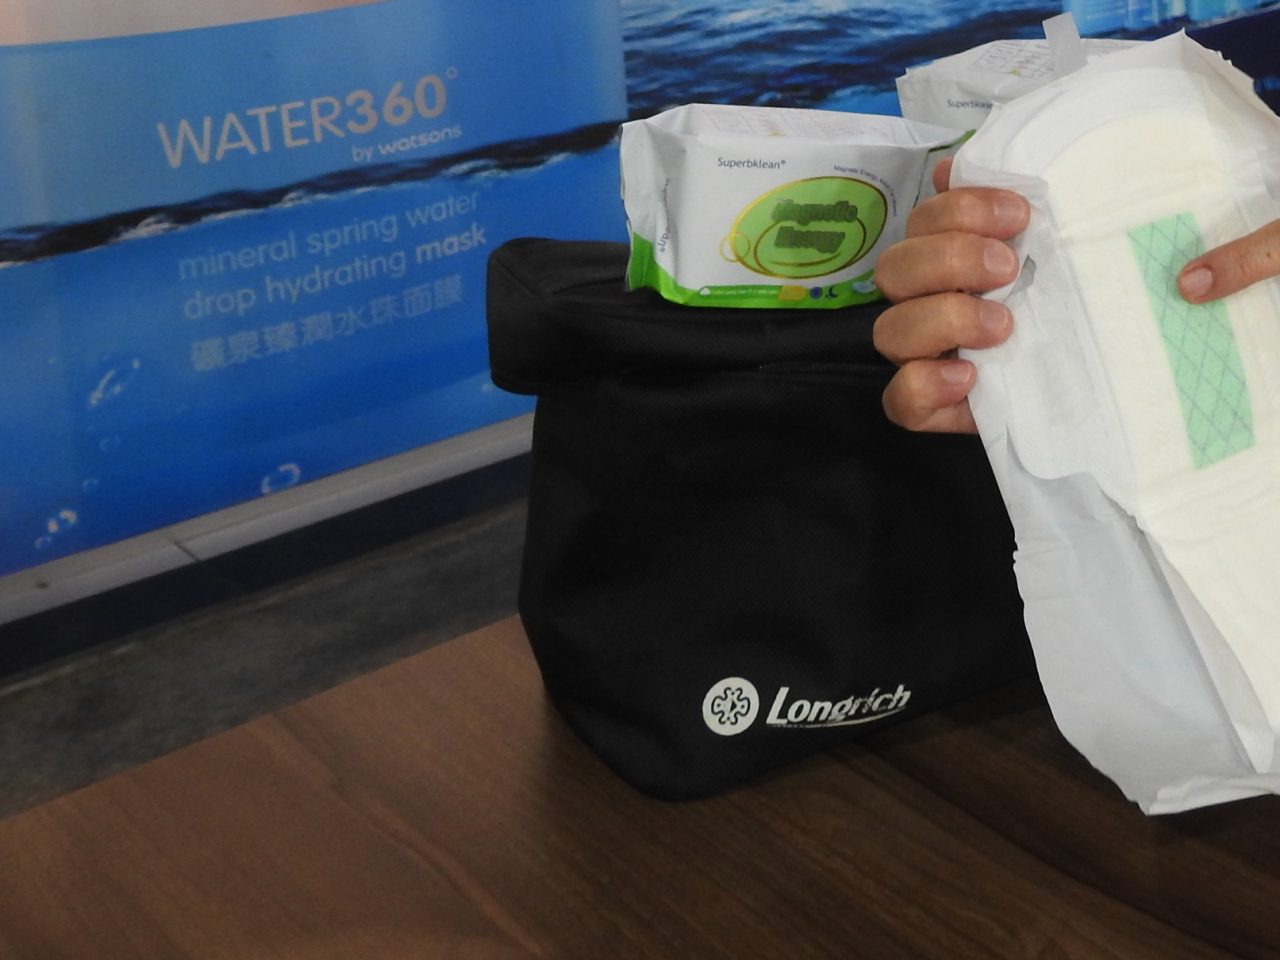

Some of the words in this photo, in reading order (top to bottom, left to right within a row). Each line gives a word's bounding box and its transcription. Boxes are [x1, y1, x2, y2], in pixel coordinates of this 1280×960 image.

[351, 143, 375, 163] by
[378, 125, 463, 157] watsons
[178, 234, 297, 281] mineral
[307, 212, 399, 259] spring
[405, 189, 482, 230] water
[183, 282, 257, 321] drop
[264, 246, 407, 306] hydrating
[415, 221, 487, 266] mask
[765, 683, 912, 727] Longrich
